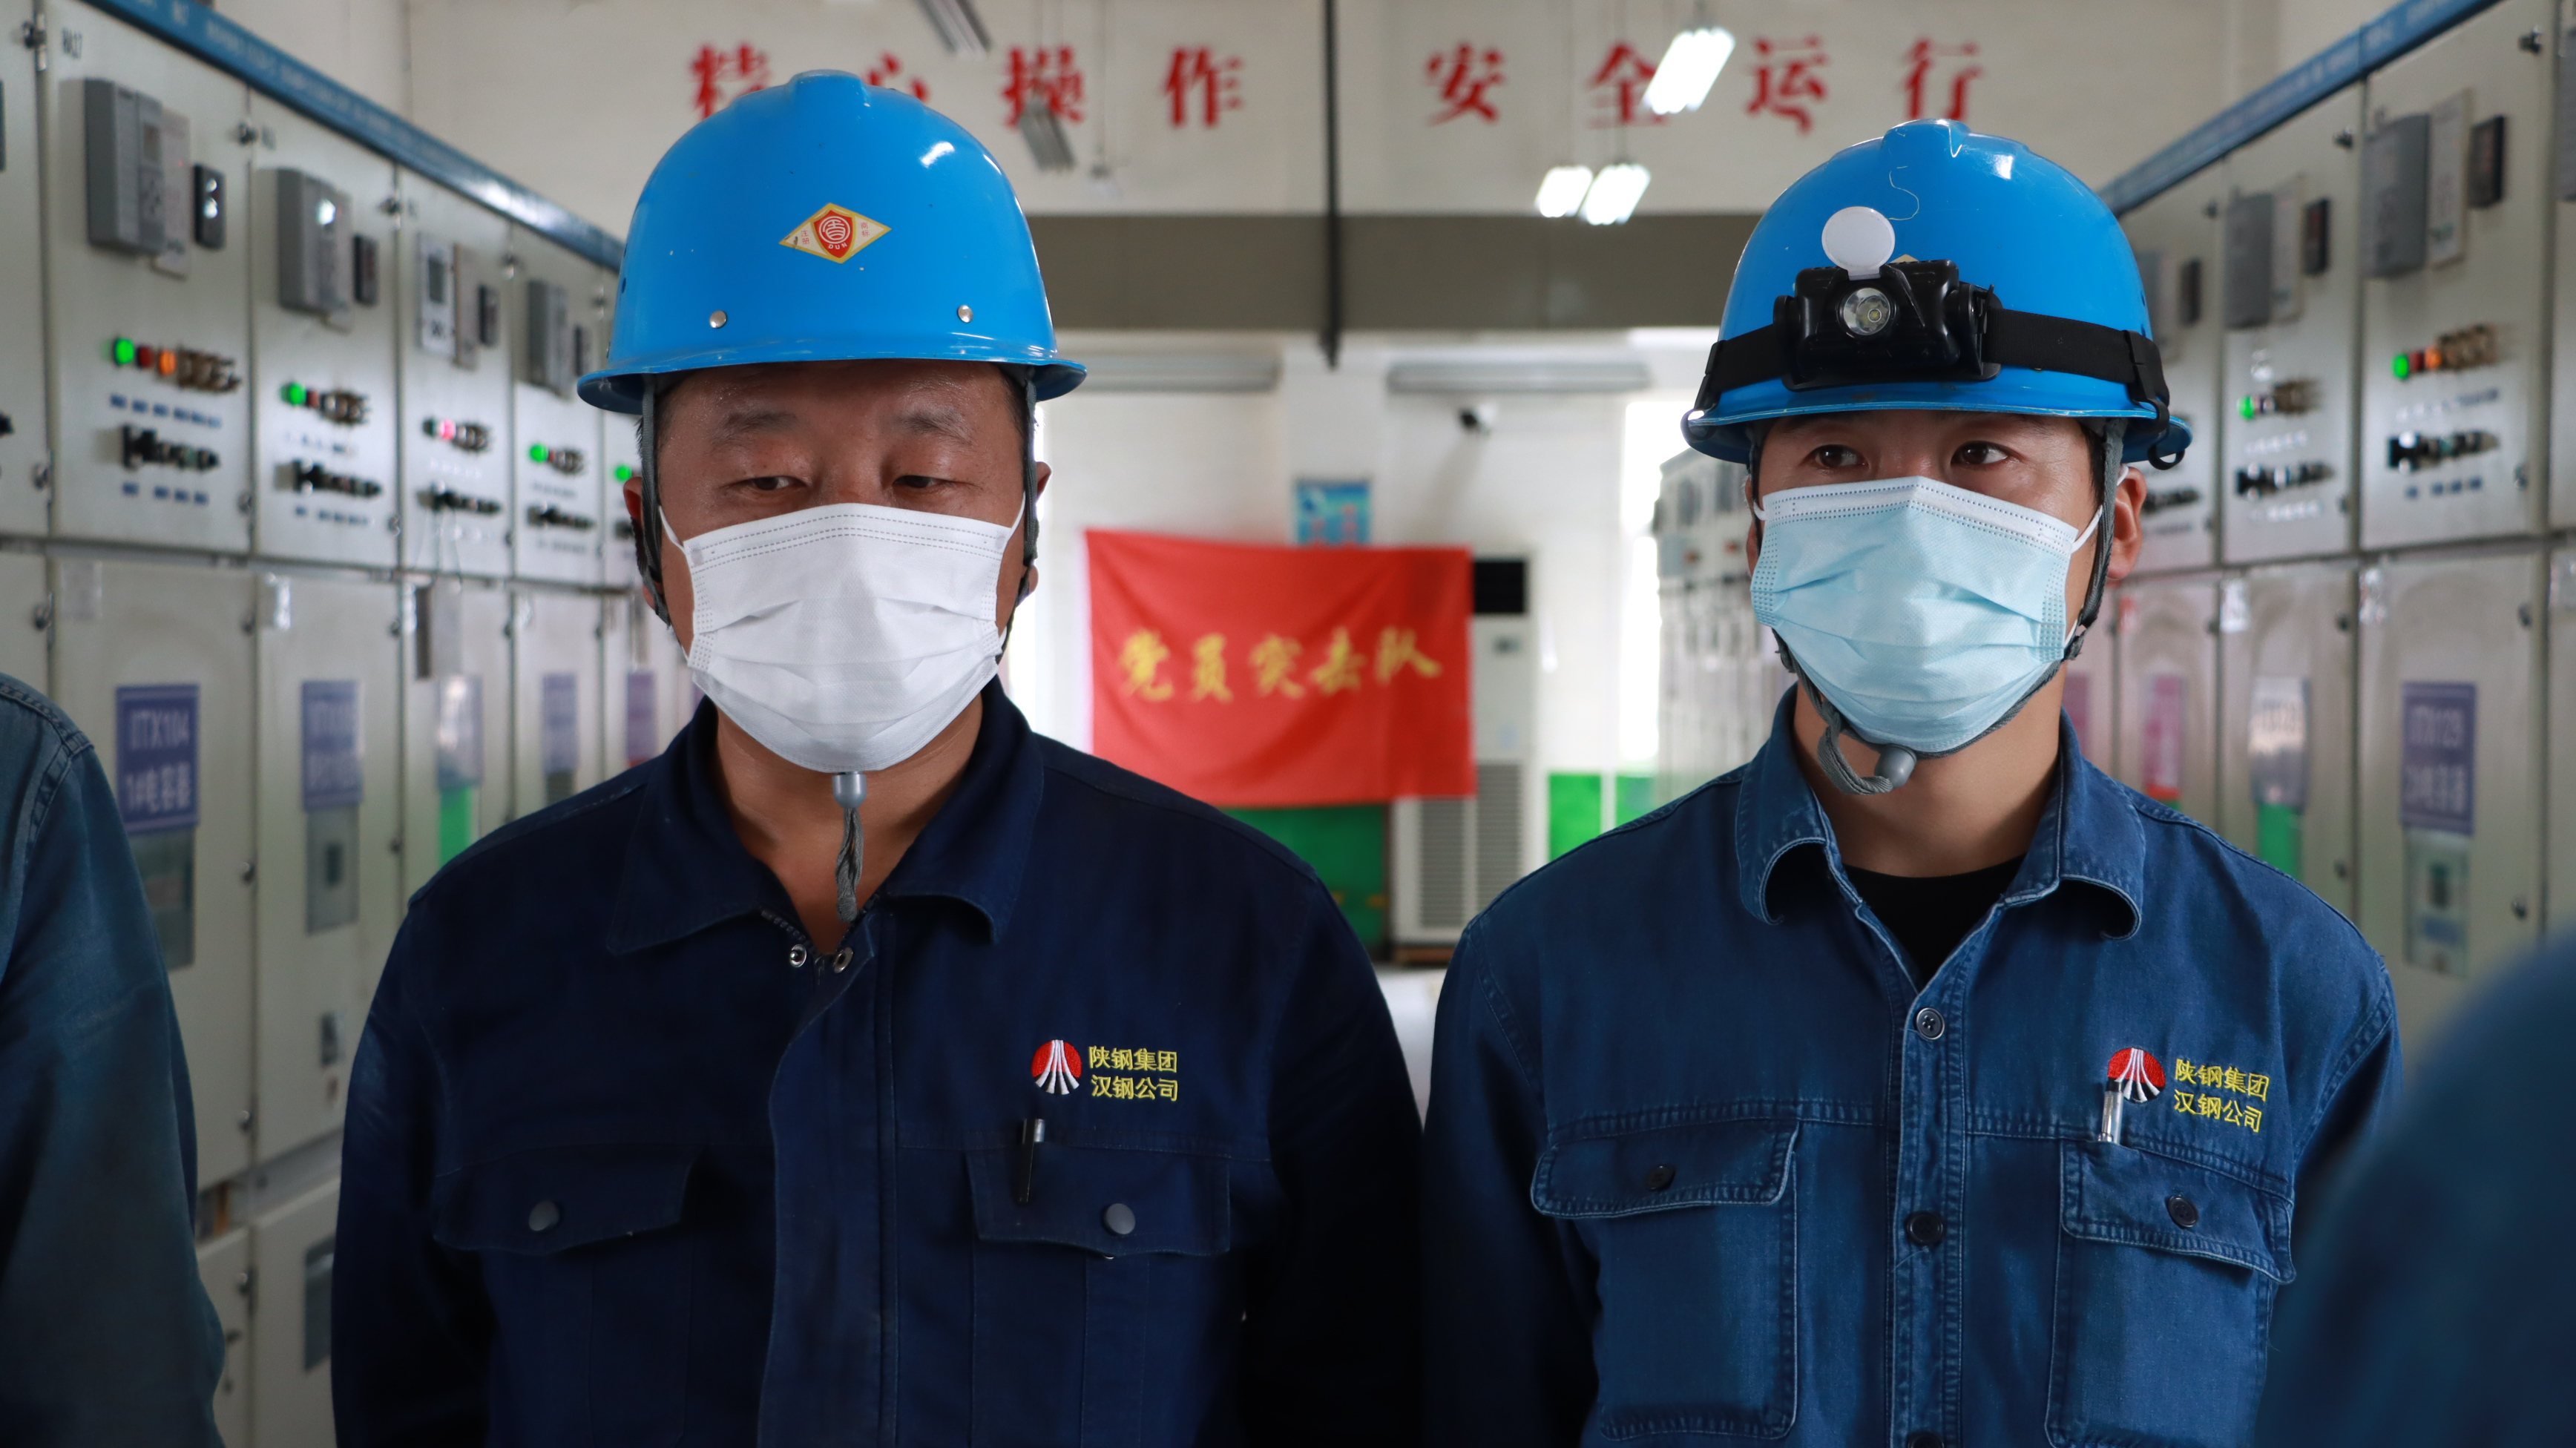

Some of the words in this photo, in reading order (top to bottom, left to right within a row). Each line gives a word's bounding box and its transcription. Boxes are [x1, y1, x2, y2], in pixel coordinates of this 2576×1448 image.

[1425, 36, 1984, 134] 安全运行
[801, 229, 809, 245] 注册
[861, 222, 870, 237] 商标
[1119, 626, 1444, 703] 党员突击队
[1088, 1045, 1177, 1073] 陕钢集团
[1091, 1074, 1178, 1102] 汉钢公司
[2175, 1058, 2270, 1102] 陕钢集团
[2173, 1088, 2262, 1133] 汉钢公司
